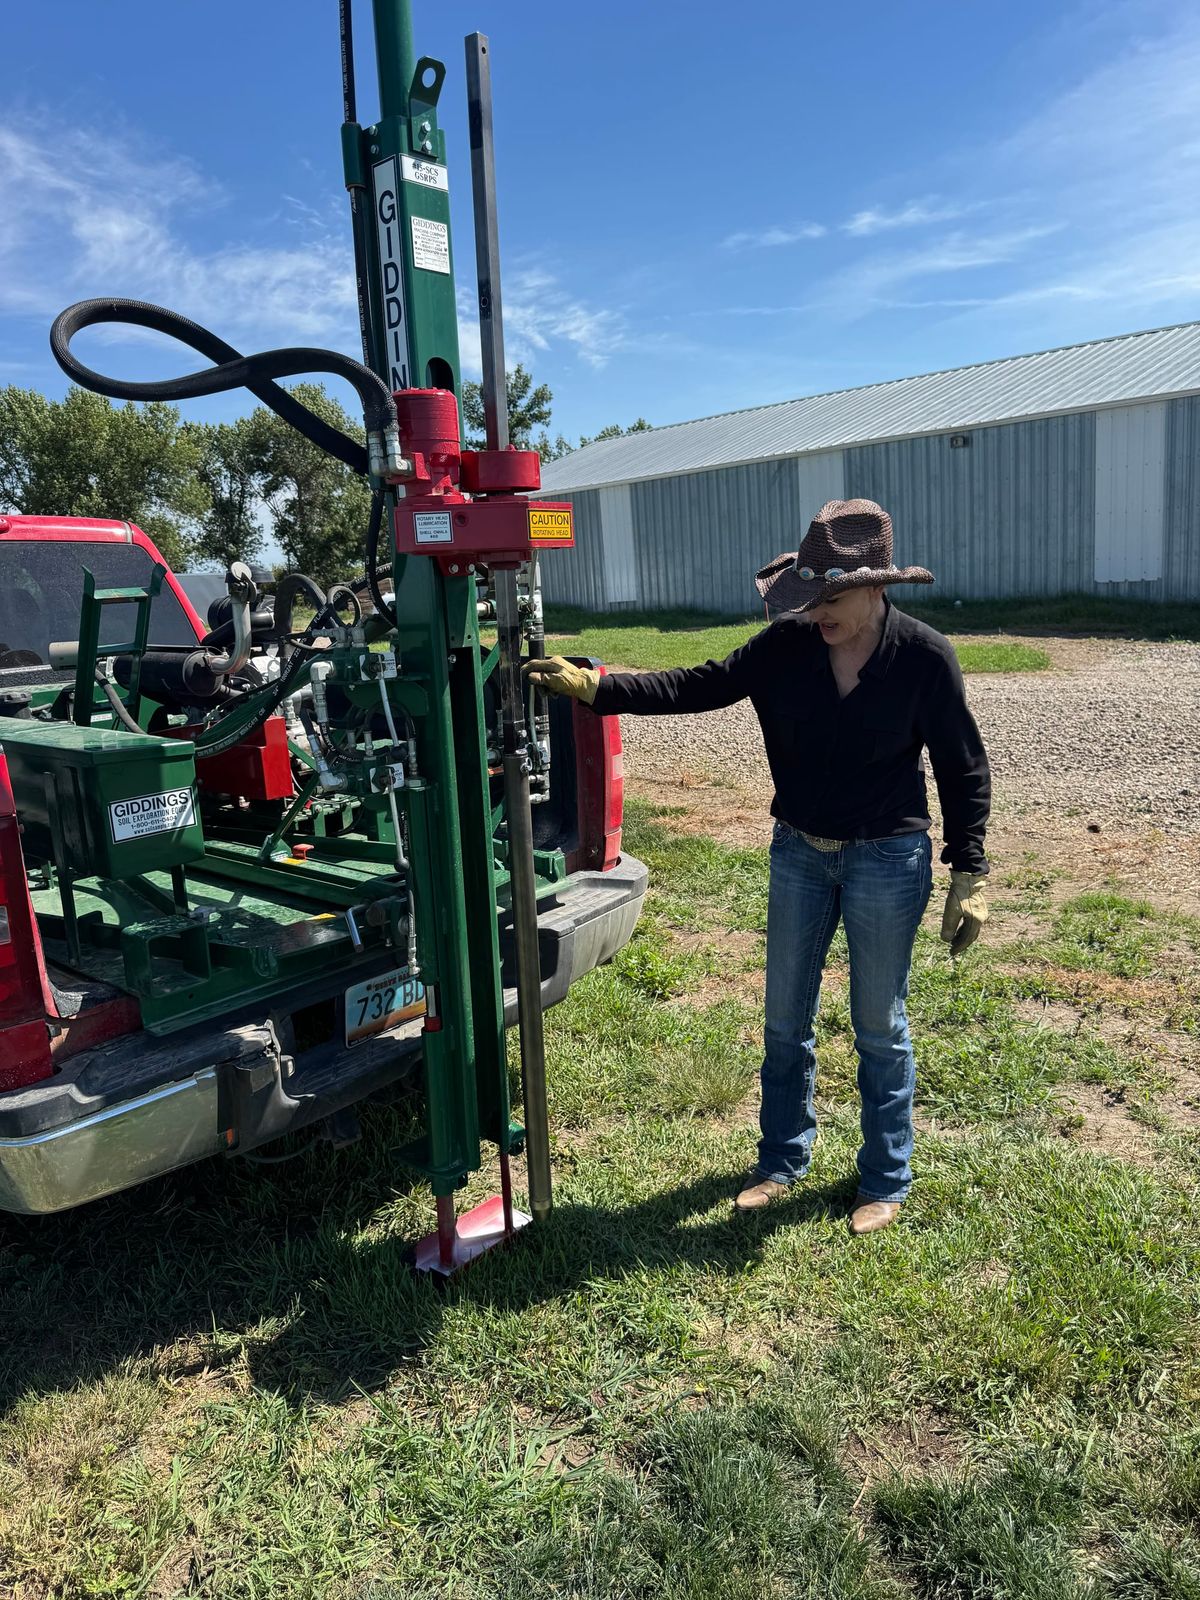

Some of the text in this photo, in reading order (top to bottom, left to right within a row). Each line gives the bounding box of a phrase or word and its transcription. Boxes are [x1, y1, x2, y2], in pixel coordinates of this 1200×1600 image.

[412, 218, 446, 233] GIDDINGS
[531, 514, 569, 525] CAUTION
[114, 792, 189, 818] GIDDINGS
[118, 817, 131, 826] SOIL
[132, 809, 170, 823] EXPLORATION
[356, 979, 425, 1027] 732 BD
